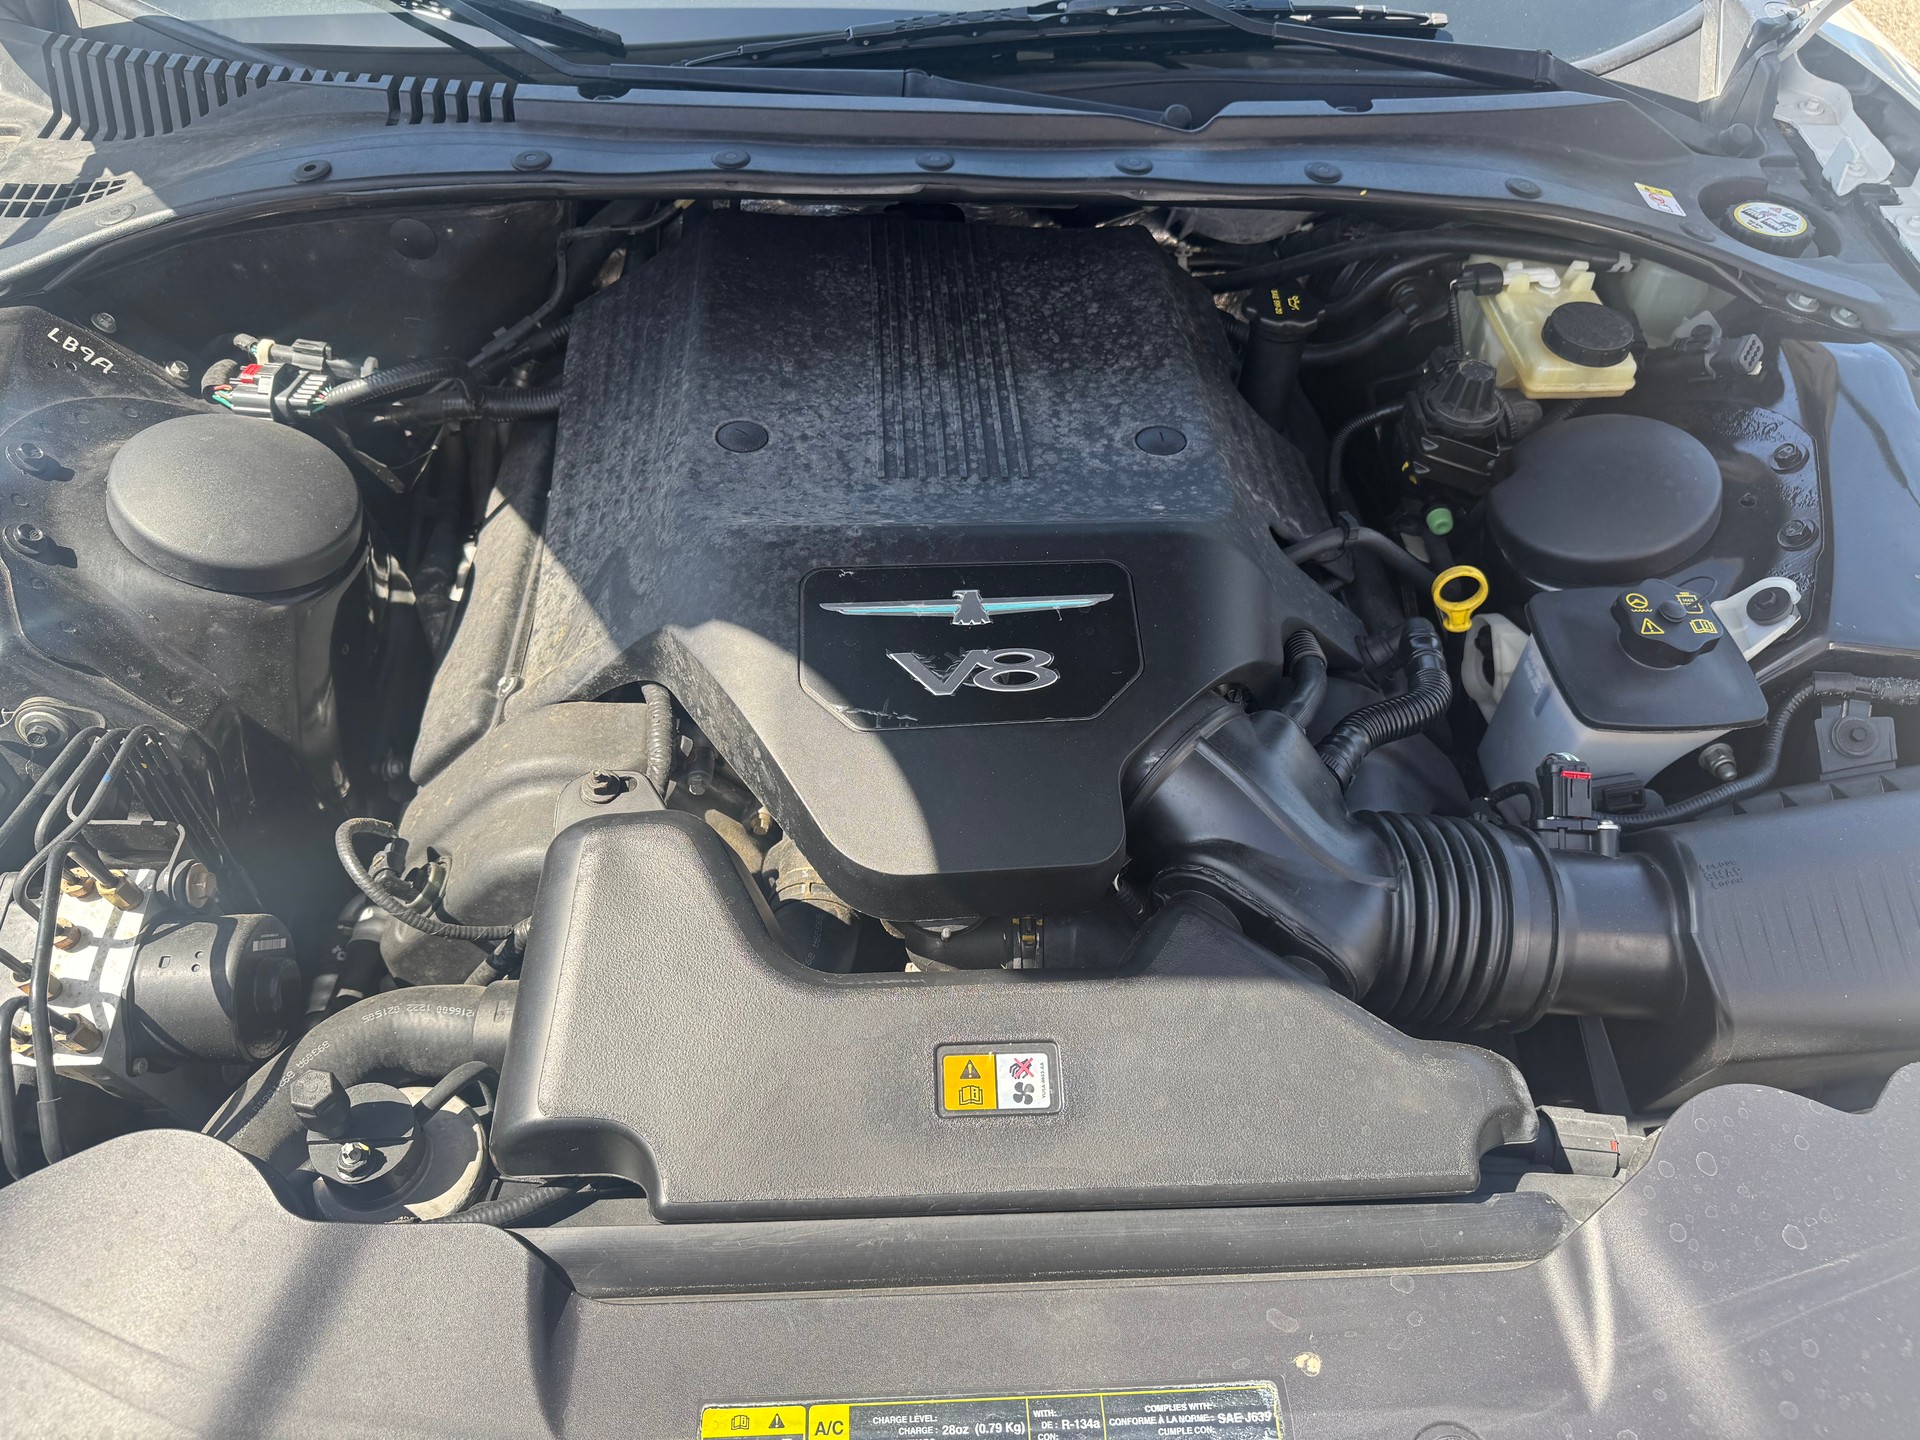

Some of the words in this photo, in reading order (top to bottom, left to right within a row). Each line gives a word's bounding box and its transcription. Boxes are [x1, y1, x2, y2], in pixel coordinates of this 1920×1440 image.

[886, 647, 1059, 696] V8
[1144, 1402, 1187, 1412] COMPLIES
[873, 1415, 907, 1424] CHARGE
[909, 1414, 938, 1423] LEVEL:
[1033, 1409, 1057, 1418] WITH:
[1108, 1416, 1157, 1426] CONFORME
[1157, 1414, 1165, 1424] À
[1166, 1415, 1178, 1424] LA
[1245, 1410, 1273, 1422] J639
[814, 1420, 844, 1436] A/C
[942, 1424, 969, 1436] 28oz
[974, 1422, 1003, 1435] (0.79
[1005, 1421, 1025, 1435] Kg)
[1061, 1418, 1101, 1430] R-134a
[1037, 1432, 1059, 1440] CON:
[1157, 1426, 1193, 1436] CUMPLE
